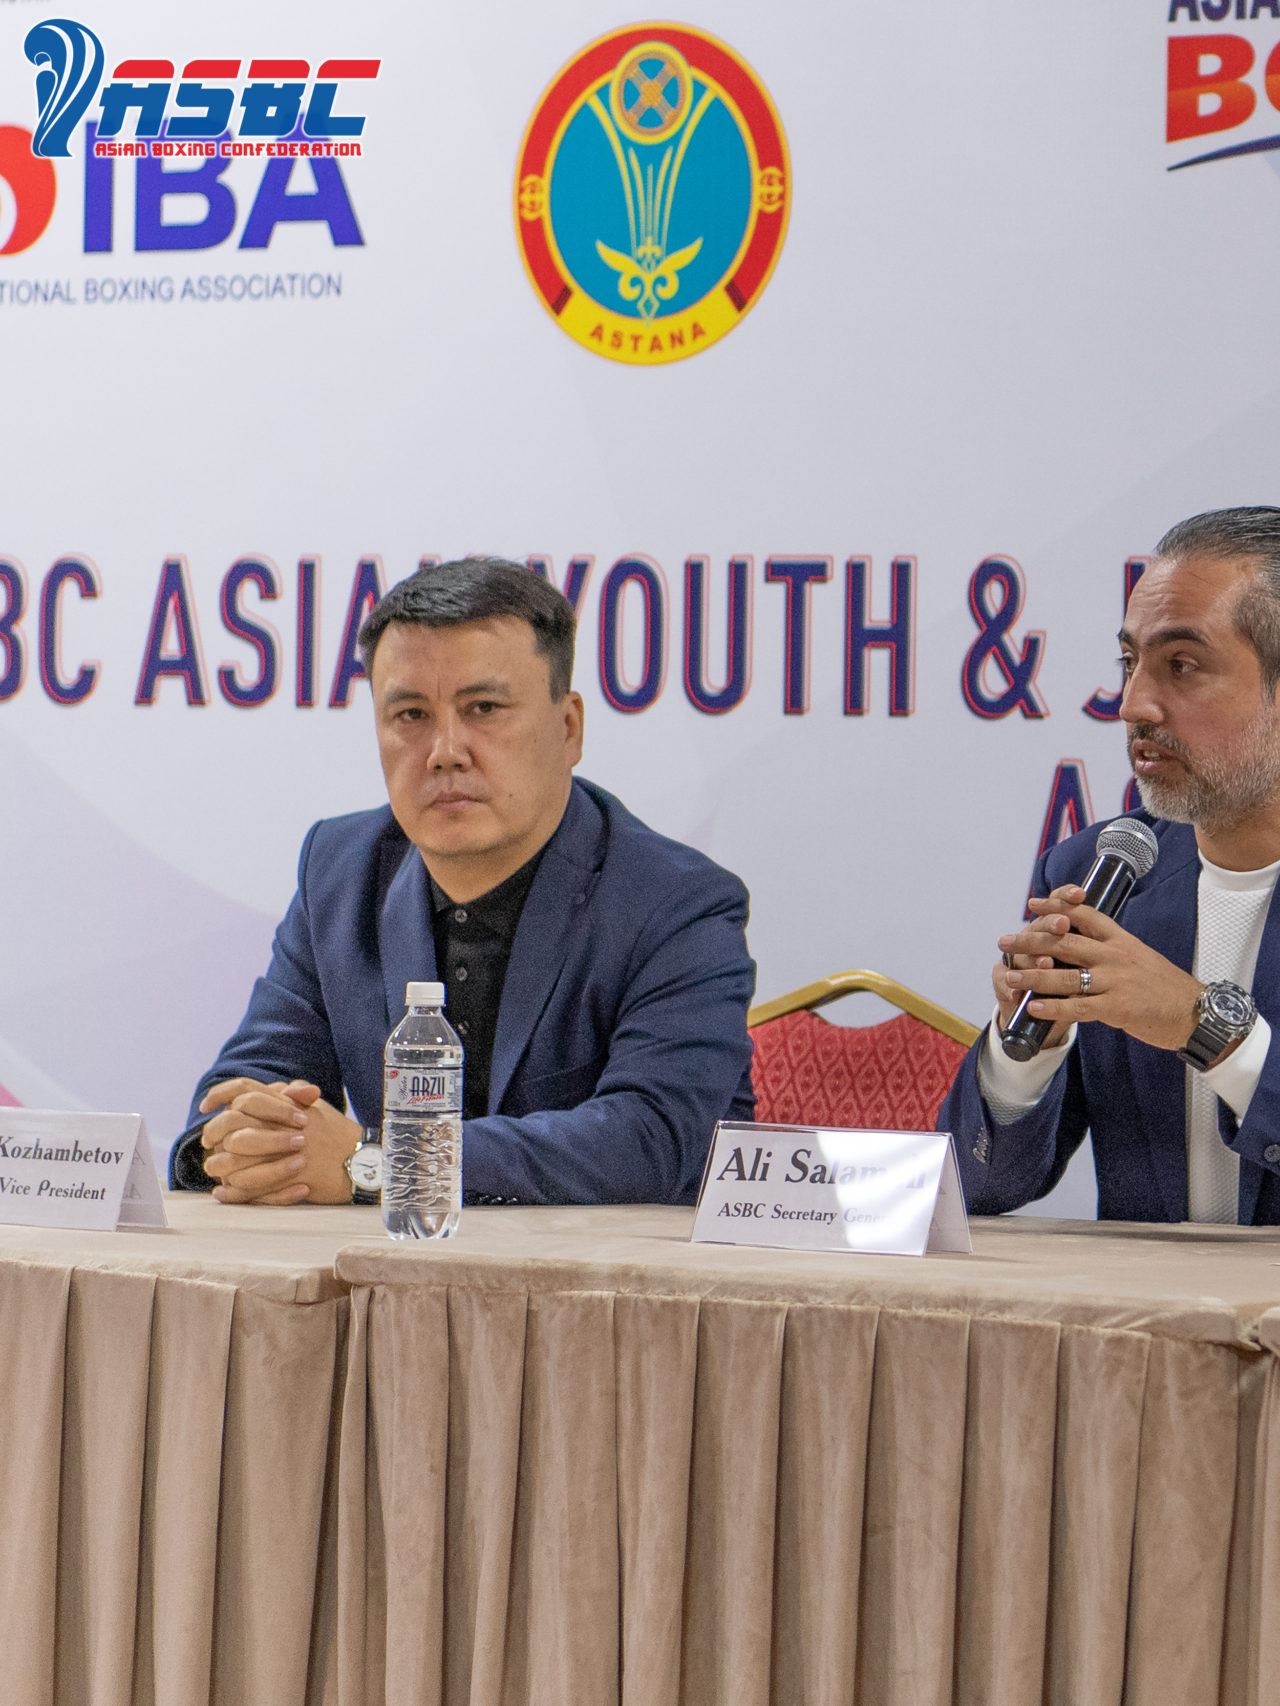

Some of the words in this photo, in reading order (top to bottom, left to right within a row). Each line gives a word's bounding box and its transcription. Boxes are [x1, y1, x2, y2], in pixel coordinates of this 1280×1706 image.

[83, 114, 366, 254] IBA
[84, 276, 174, 304] BOXING
[180, 272, 342, 301] ASSOCIATION
[589, 321, 706, 353] ASTANA
[961, 554, 1050, 721] &
[0, 1136, 124, 1165] Kozhambetov
[716, 1146, 772, 1182] Ali
[0, 1176, 31, 1196] Vice
[37, 1179, 106, 1200] President
[717, 1202, 765, 1219] ASBC
[771, 1204, 838, 1225] Secretary
